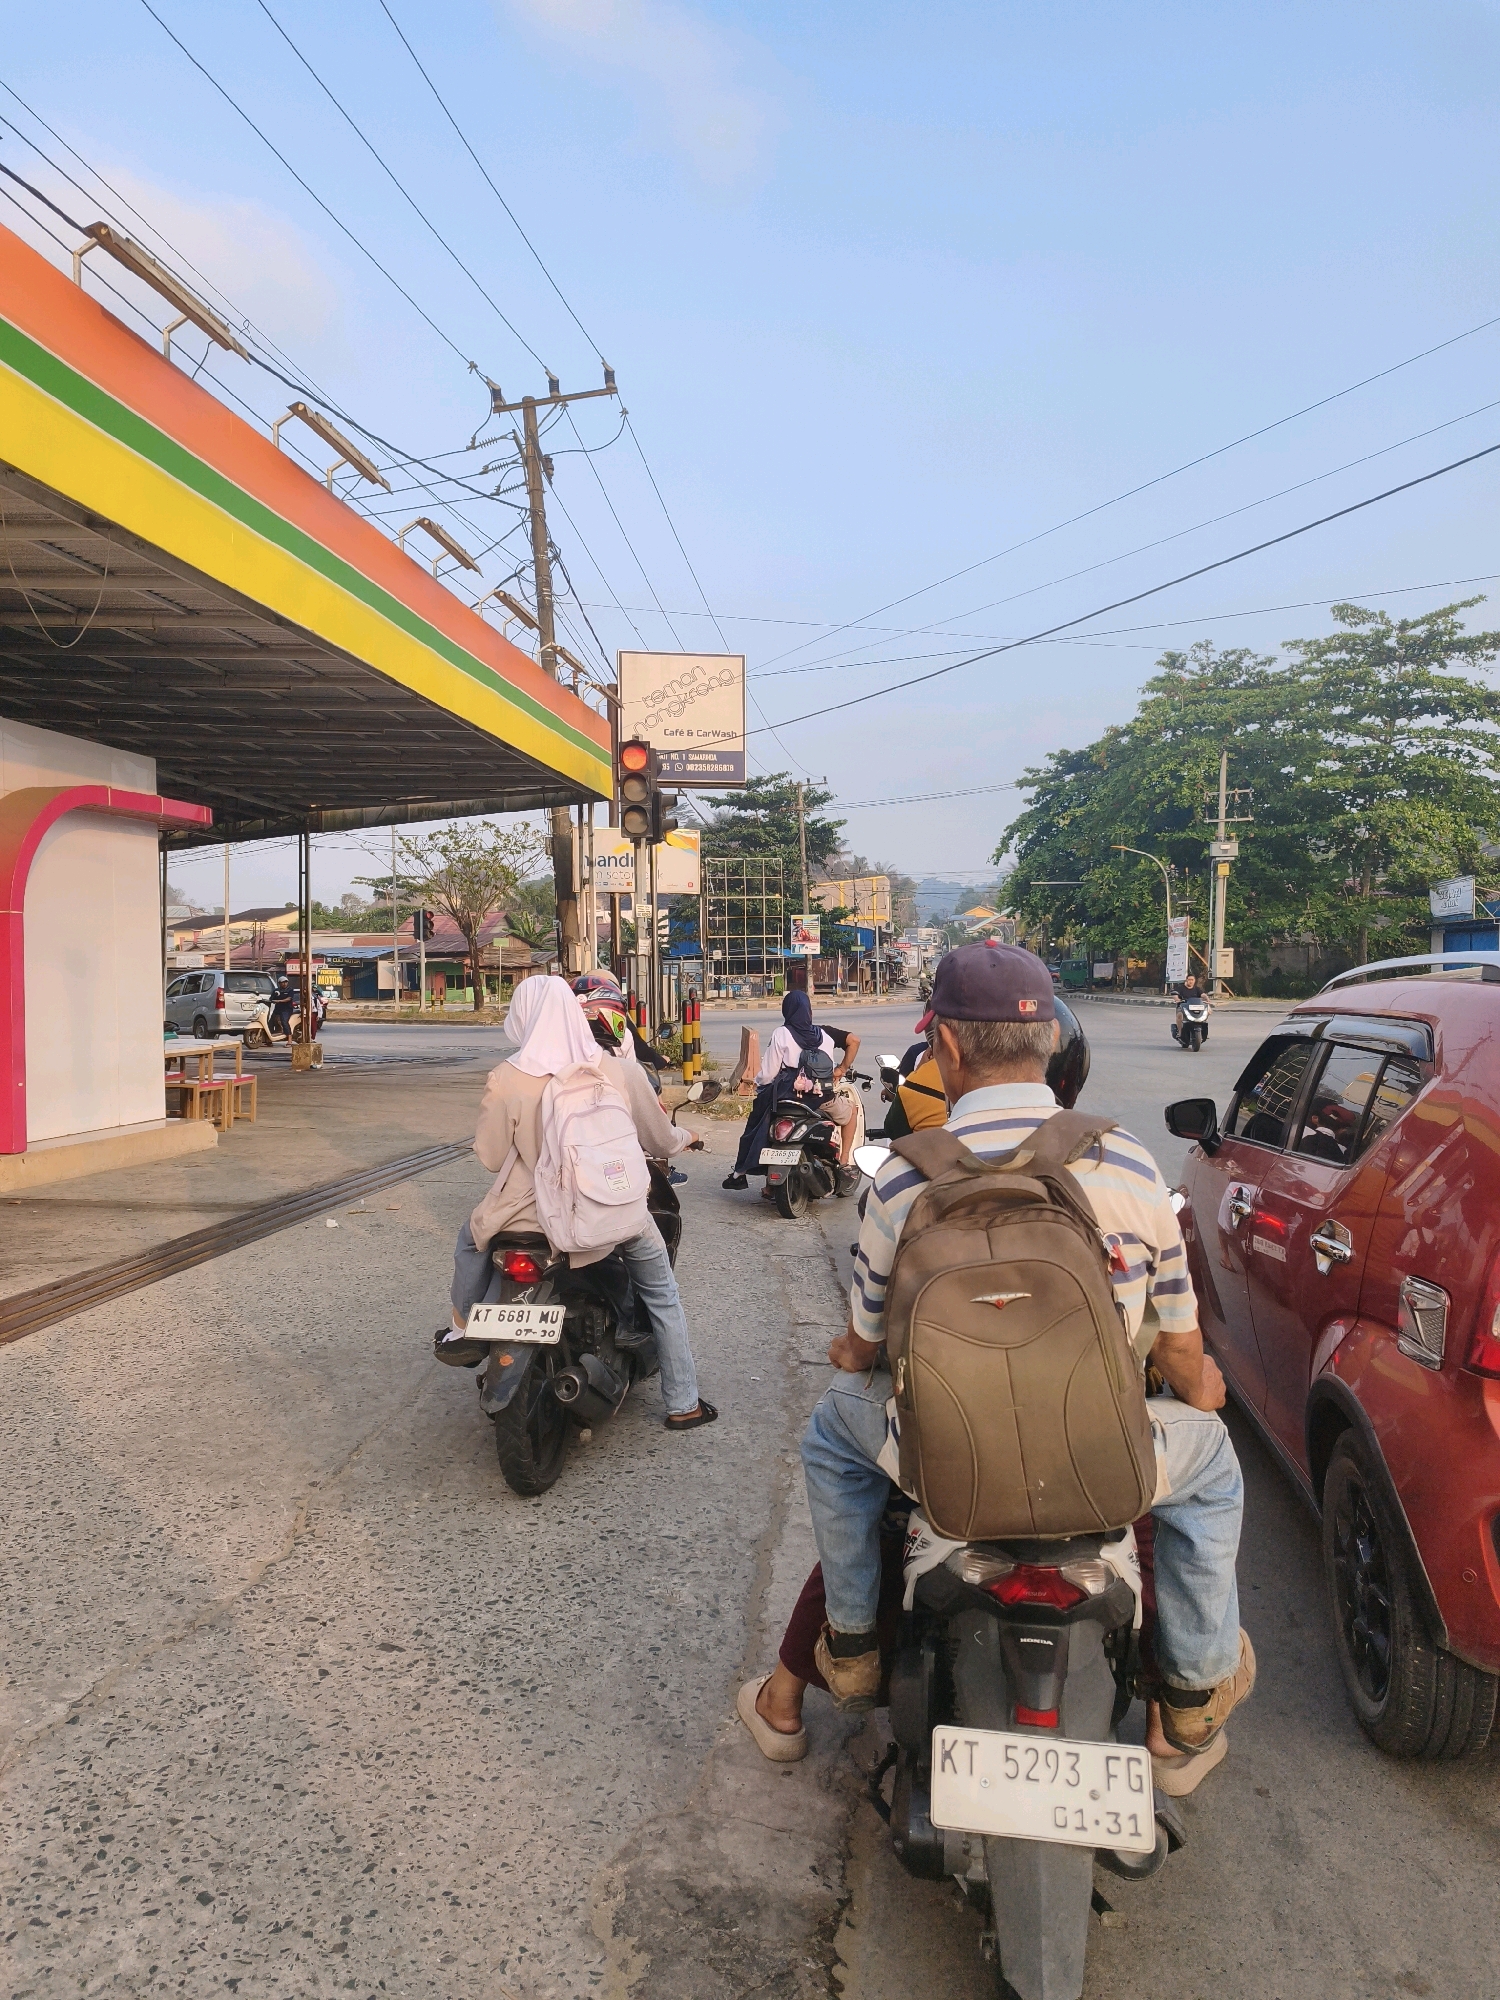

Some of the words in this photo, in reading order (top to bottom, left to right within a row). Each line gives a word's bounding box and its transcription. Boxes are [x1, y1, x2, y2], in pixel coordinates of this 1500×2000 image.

[664, 728, 685, 737] Café
[686, 729, 694, 737] &
[696, 729, 737, 738] CarWash
[761, 1149, 771, 1157] KT
[473, 1308, 492, 1322] KT
[498, 1309, 531, 1323] 6681
[539, 1310, 560, 1324] MU
[1019, 1637, 1054, 1646] HONDA
[940, 1738, 979, 1777] KT
[1004, 1745, 1081, 1788] 5293
[1105, 1755, 1144, 1794] FG
